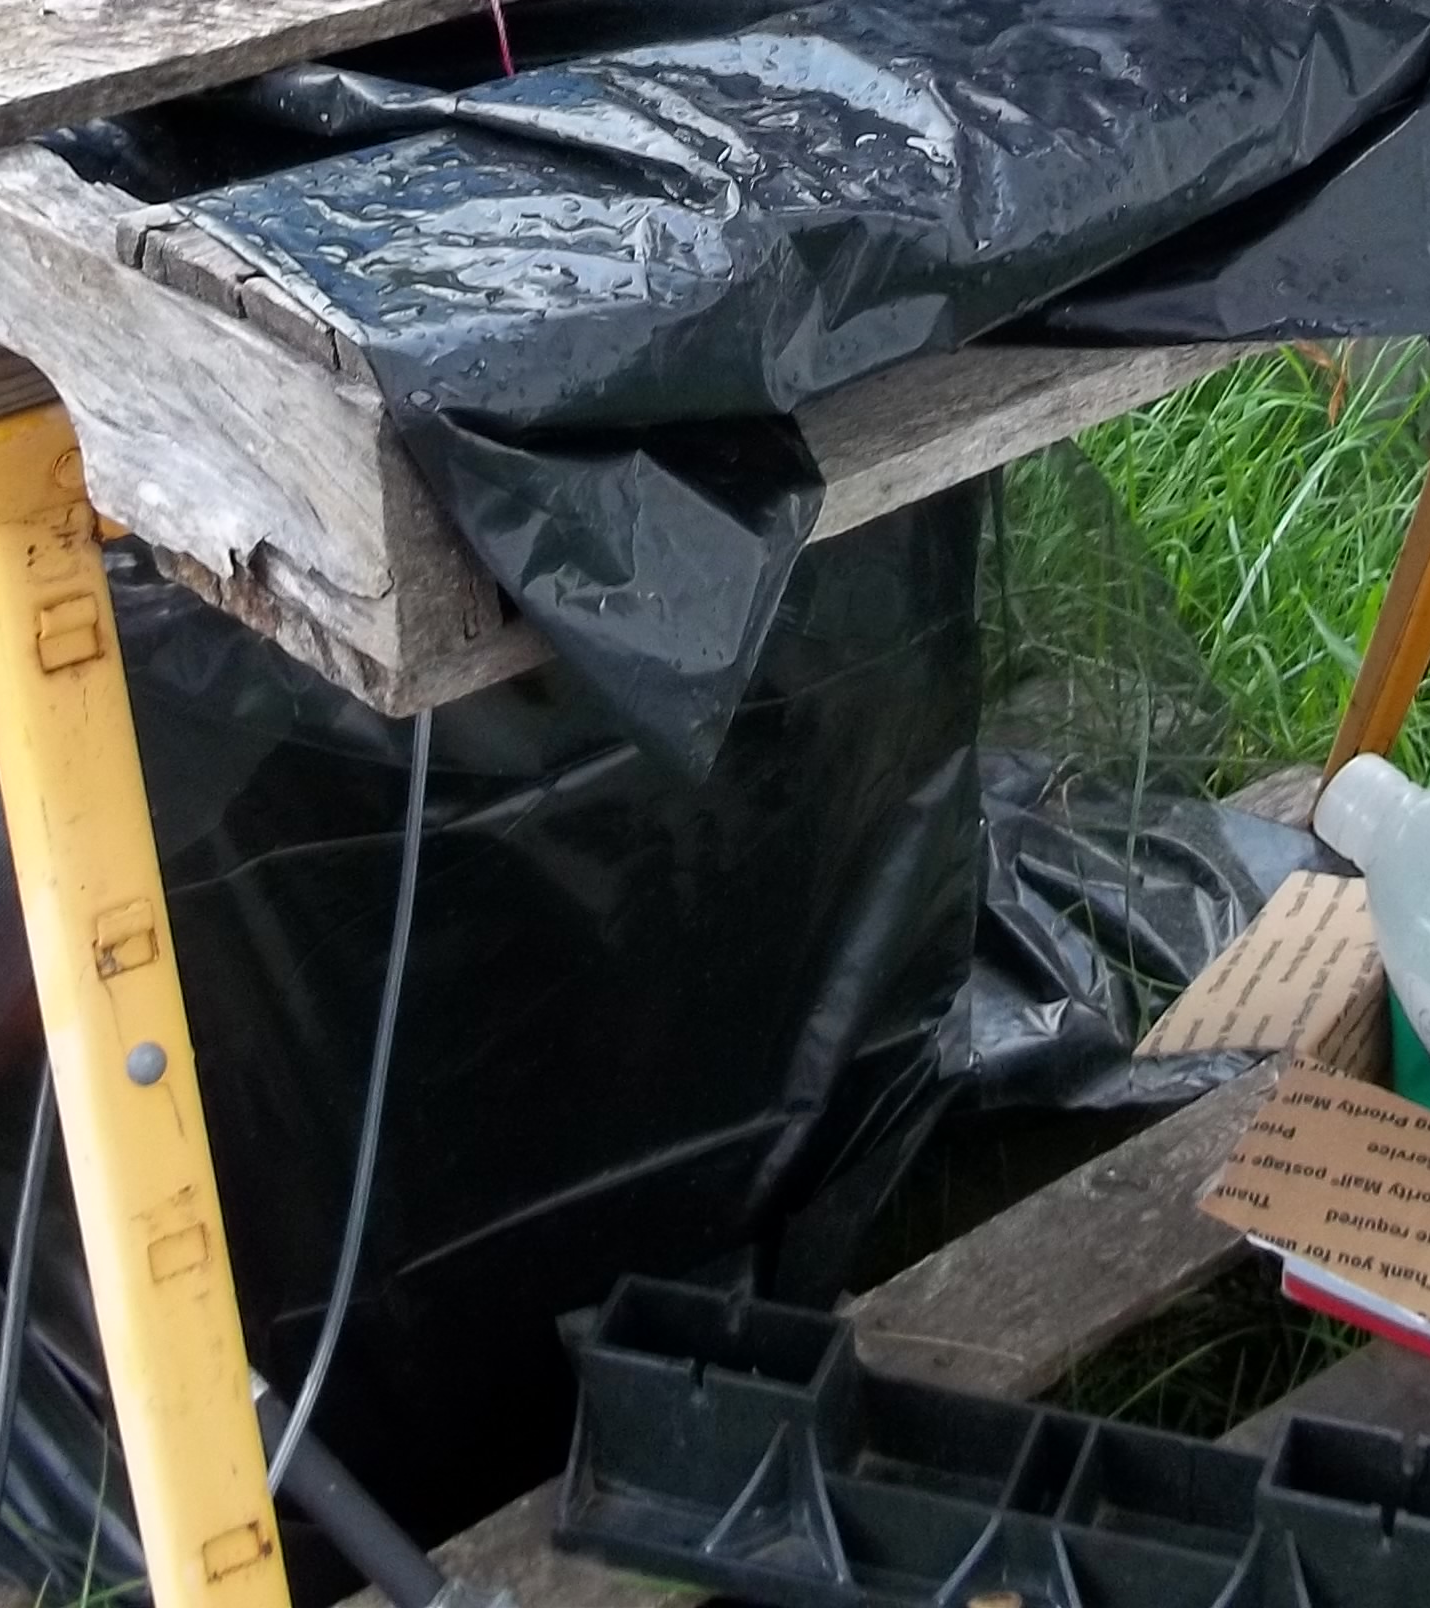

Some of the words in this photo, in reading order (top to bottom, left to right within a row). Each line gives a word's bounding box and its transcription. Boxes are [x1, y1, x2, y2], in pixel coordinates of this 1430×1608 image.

[1336, 1099, 1409, 1128] Priority
[1251, 1154, 1327, 1179] postage
[1324, 1208, 1409, 1238] required
[1303, 1243, 1331, 1263] for
[1337, 1251, 1374, 1271] you
